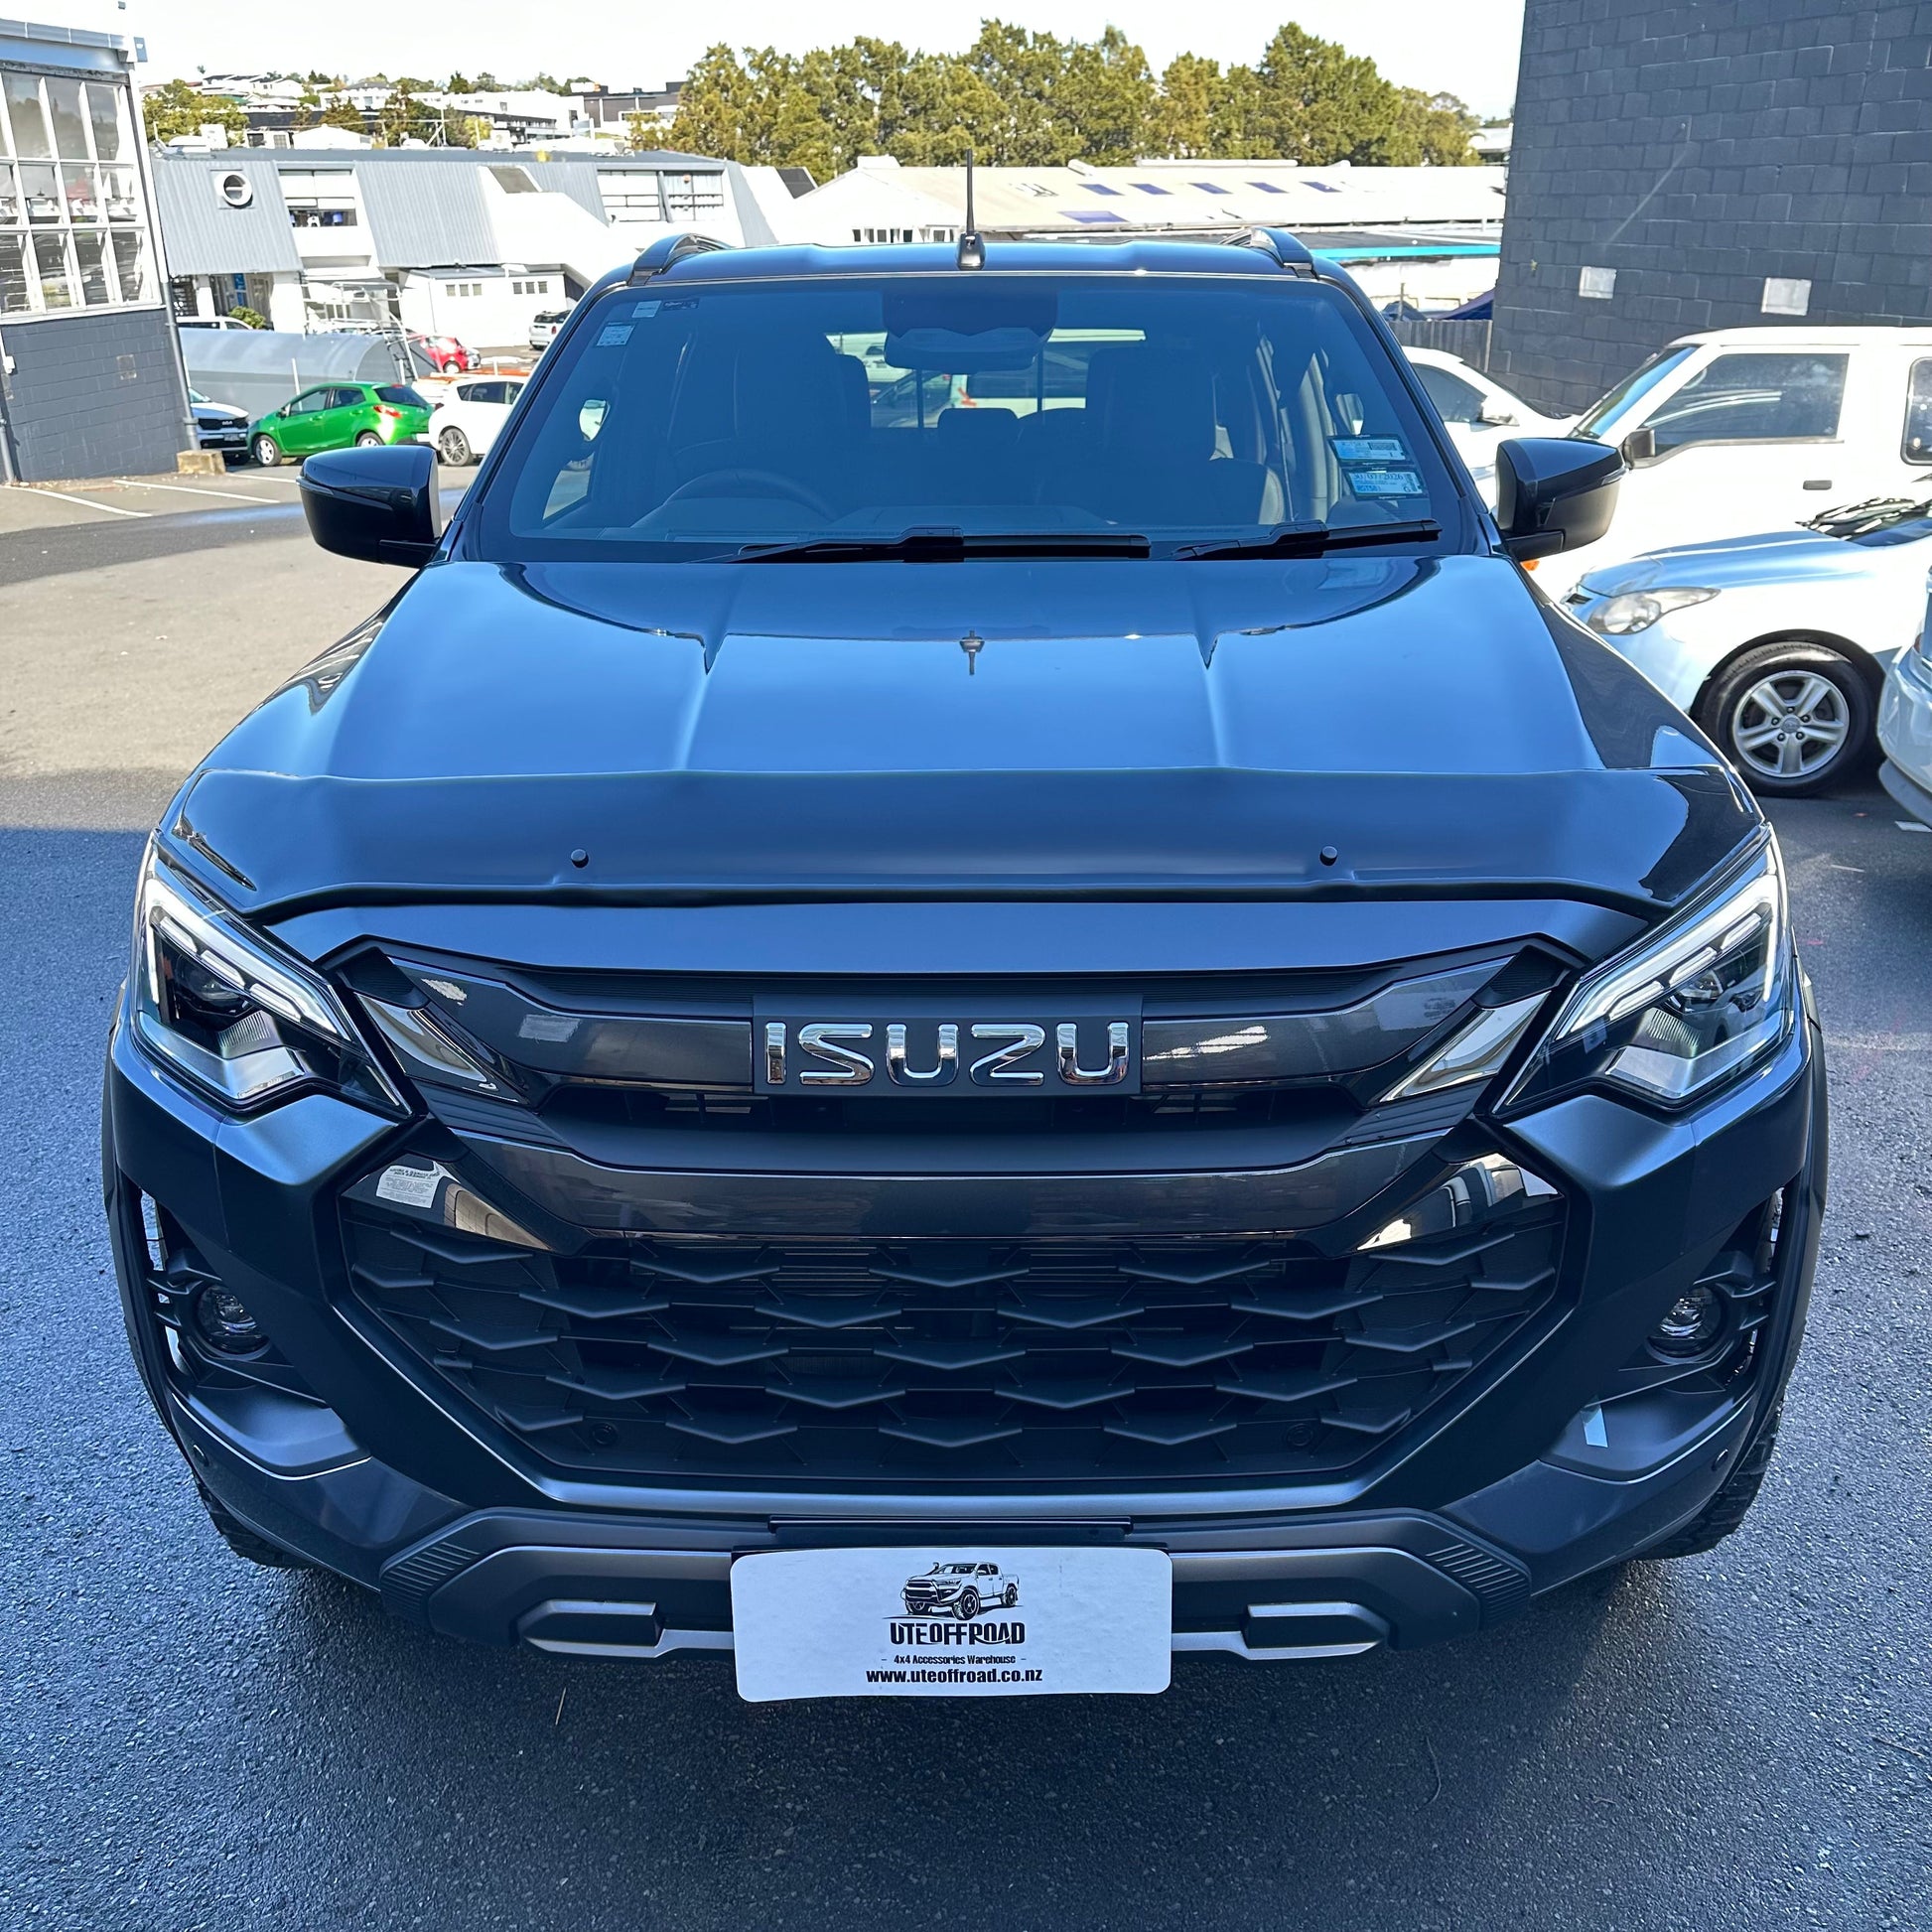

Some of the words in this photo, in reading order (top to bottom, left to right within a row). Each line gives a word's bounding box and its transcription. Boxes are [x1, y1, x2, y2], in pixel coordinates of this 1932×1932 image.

[764, 1022, 1130, 1087] ISUZU
[890, 1622, 1026, 1645] UTEOFFROAD
[894, 1655, 911, 1664] 4x4
[912, 1655, 966, 1665] Accessories
[967, 1654, 1016, 1664] Warehouse
[866, 1668, 1043, 1683] www.uteoffroad.co.nz
